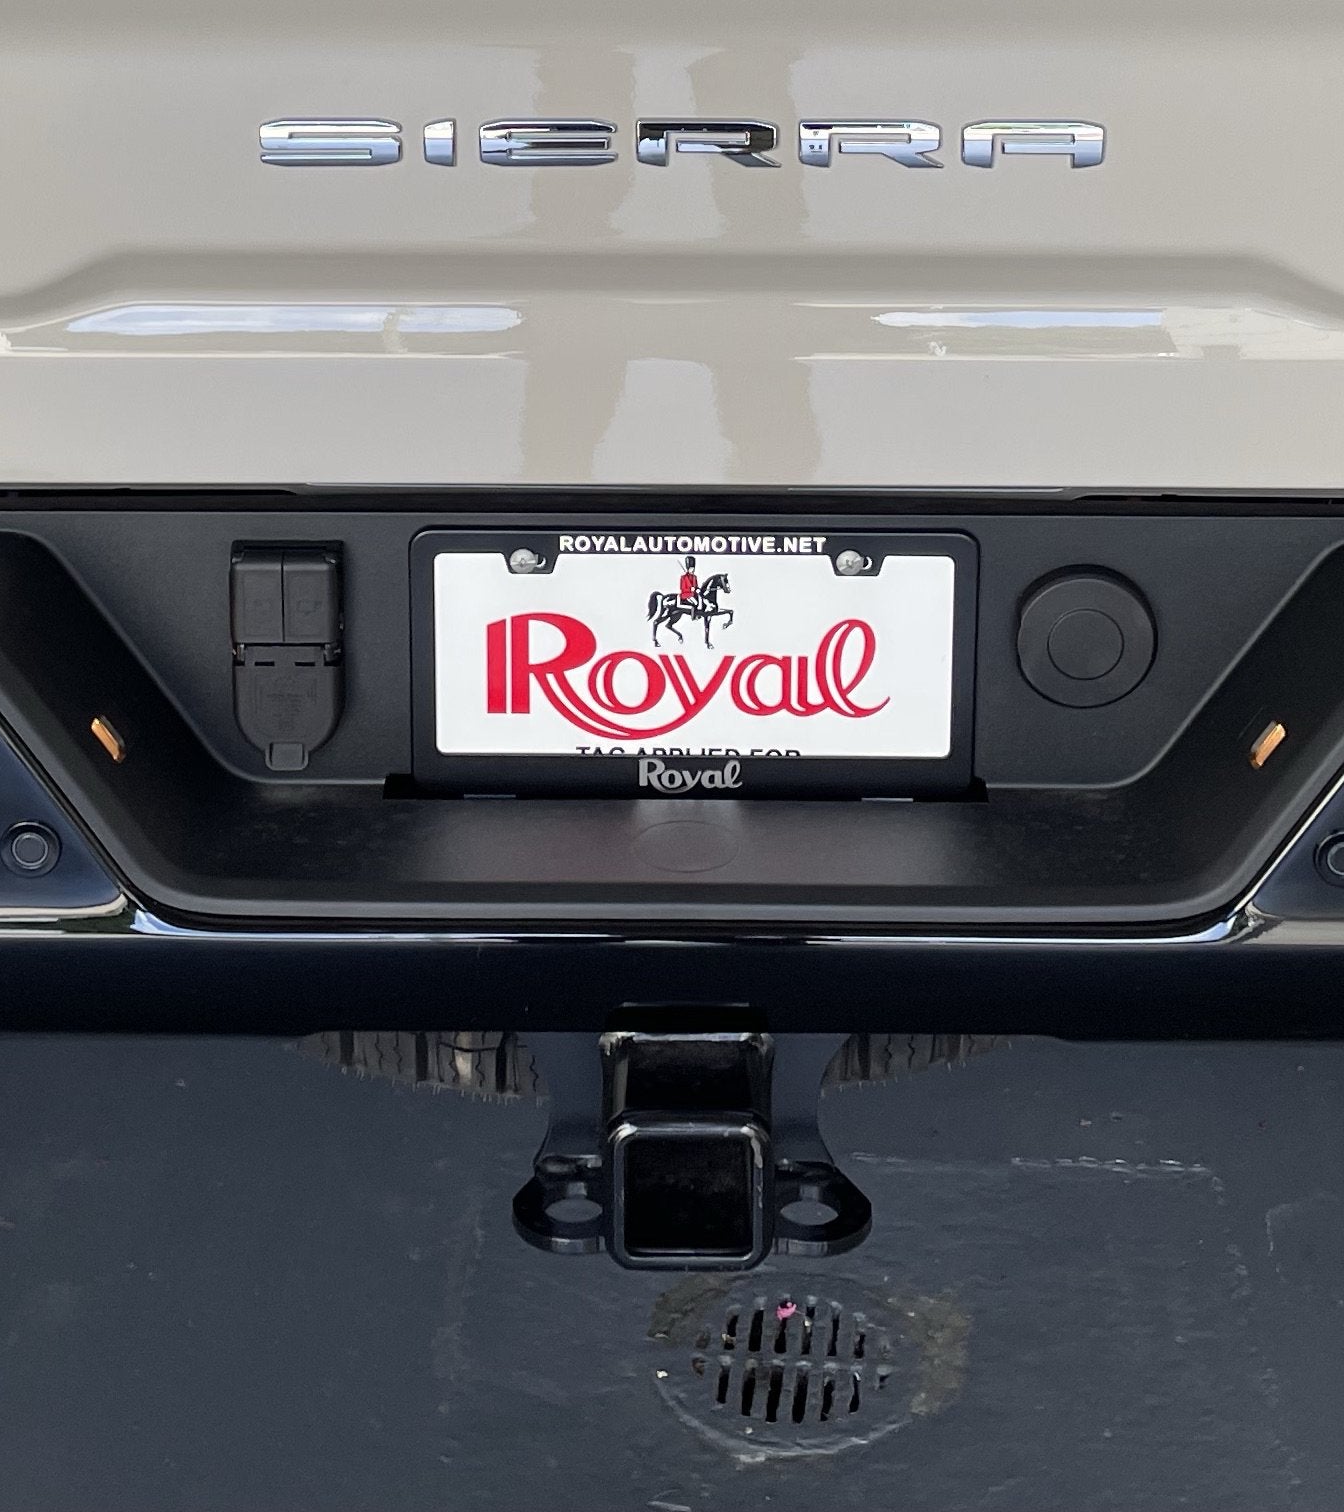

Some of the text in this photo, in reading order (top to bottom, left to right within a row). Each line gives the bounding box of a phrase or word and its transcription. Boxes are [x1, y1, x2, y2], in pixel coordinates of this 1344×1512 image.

[258, 117, 1106, 169] SIERRA
[558, 534, 827, 555] ROYALAUTOMOTIVE.NET
[486, 611, 891, 740] Royal
[638, 757, 743, 794] Royal
